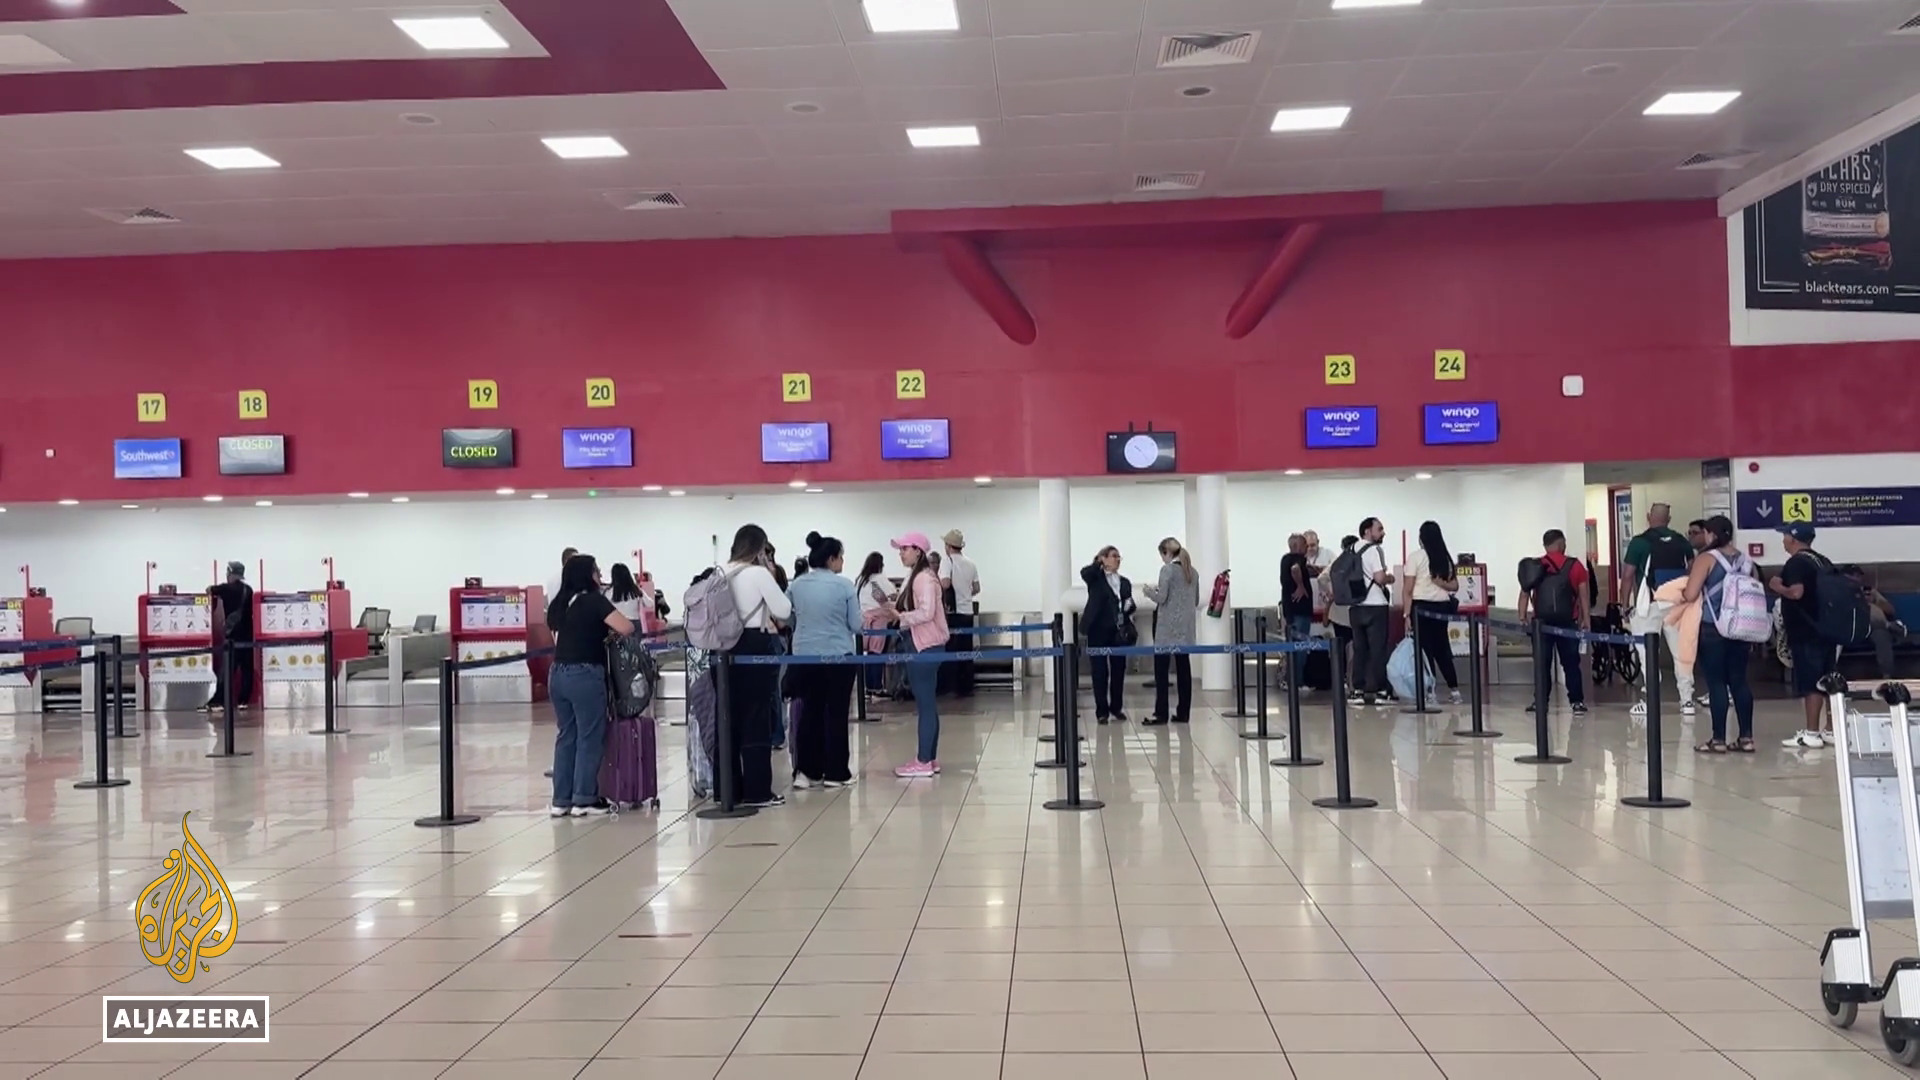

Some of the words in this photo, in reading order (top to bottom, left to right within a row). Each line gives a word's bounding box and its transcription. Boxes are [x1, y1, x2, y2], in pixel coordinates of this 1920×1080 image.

[1820, 182, 1838, 193] DRY
[1840, 182, 1870, 195] SPICED
[1835, 198, 1856, 209] RUM
[1805, 280, 1889, 295] blacktears.com
[1329, 361, 1351, 378] 23
[1439, 356, 1461, 373] 24
[788, 379, 806, 395] 21
[900, 377, 921, 393] 22
[473, 386, 493, 402] 19
[590, 385, 611, 400] 20
[142, 399, 161, 415] 17
[244, 397, 263, 412] 18
[1323, 411, 1360, 422] wingo
[1442, 407, 1479, 418] wingo
[778, 427, 813, 438] wingo
[897, 424, 932, 435] wingo
[230, 438, 273, 450] CLOSED
[579, 433, 615, 444] wingo
[120, 449, 168, 462] Southwest
[450, 446, 498, 459] CLOSED
